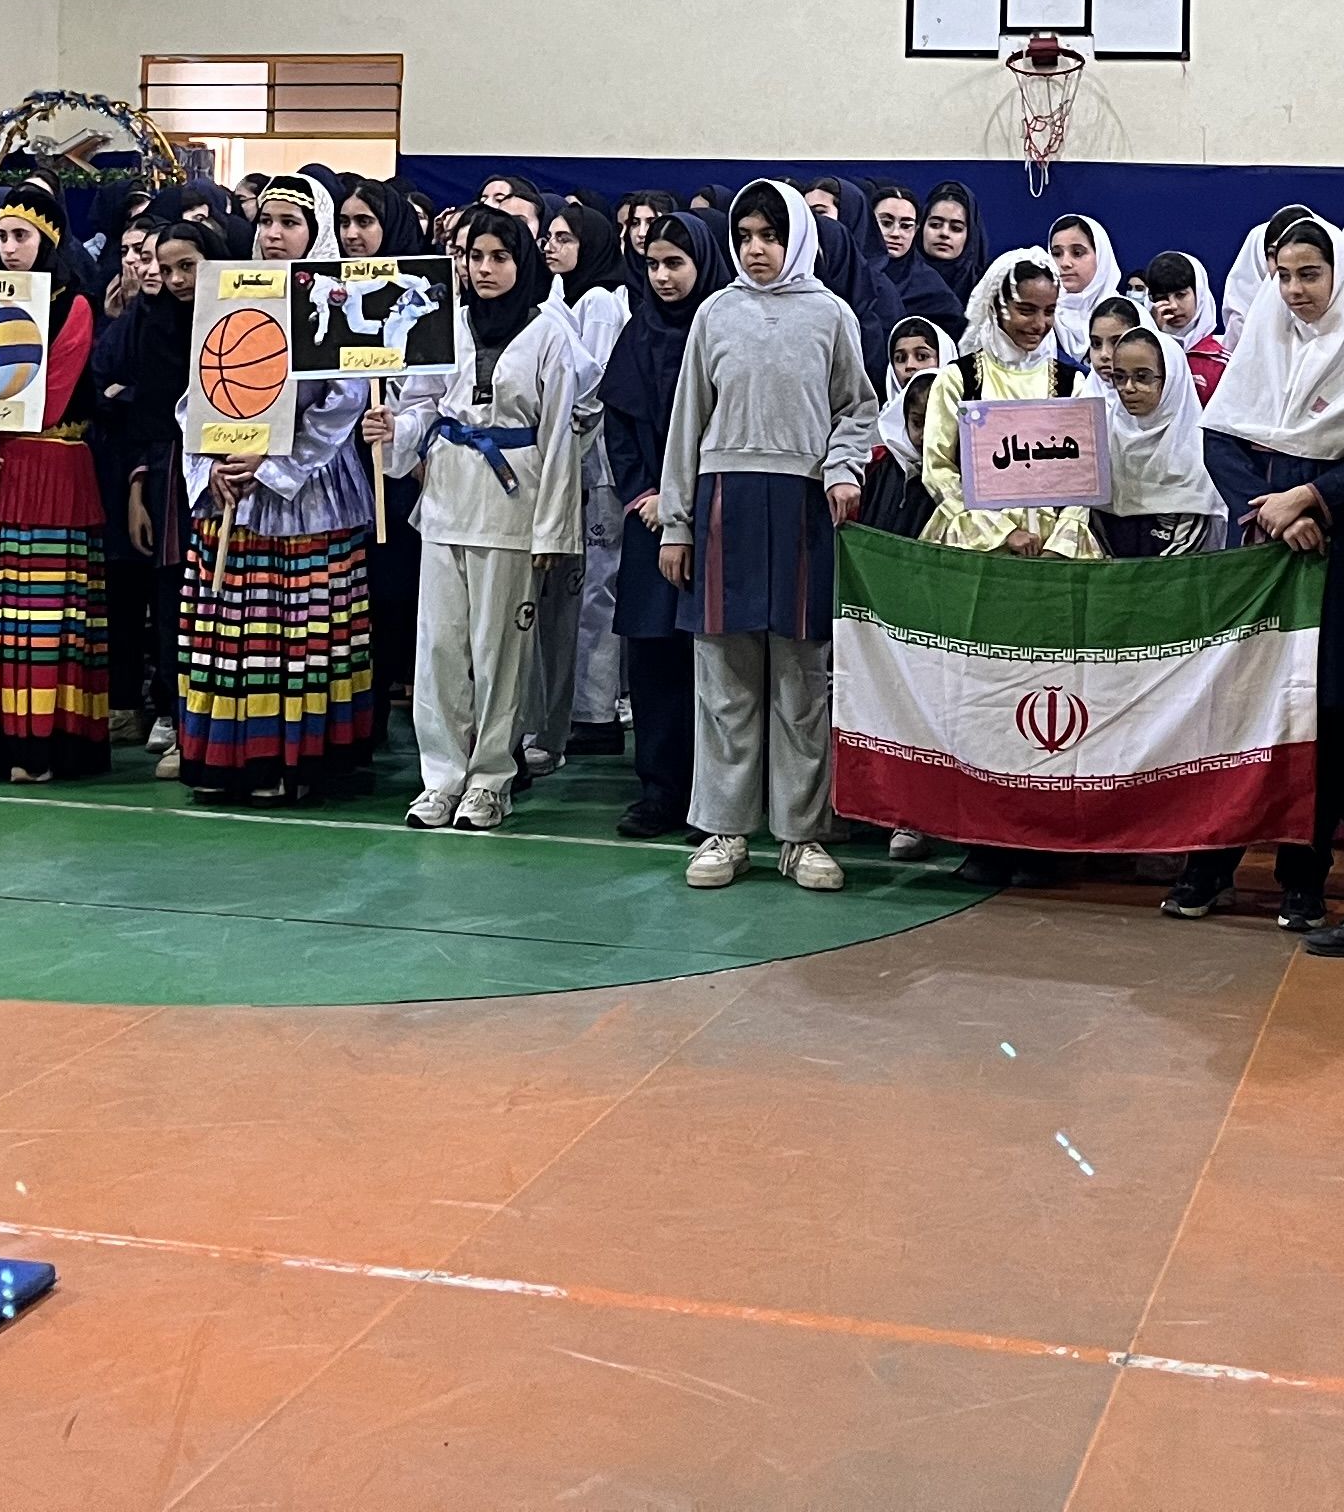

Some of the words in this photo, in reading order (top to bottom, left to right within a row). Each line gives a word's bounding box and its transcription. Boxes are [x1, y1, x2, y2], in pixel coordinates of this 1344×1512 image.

[343, 262, 396, 280] تکواندو
[233, 273, 274, 289] بسکتبال
[992, 434, 1079, 470] هندبال
